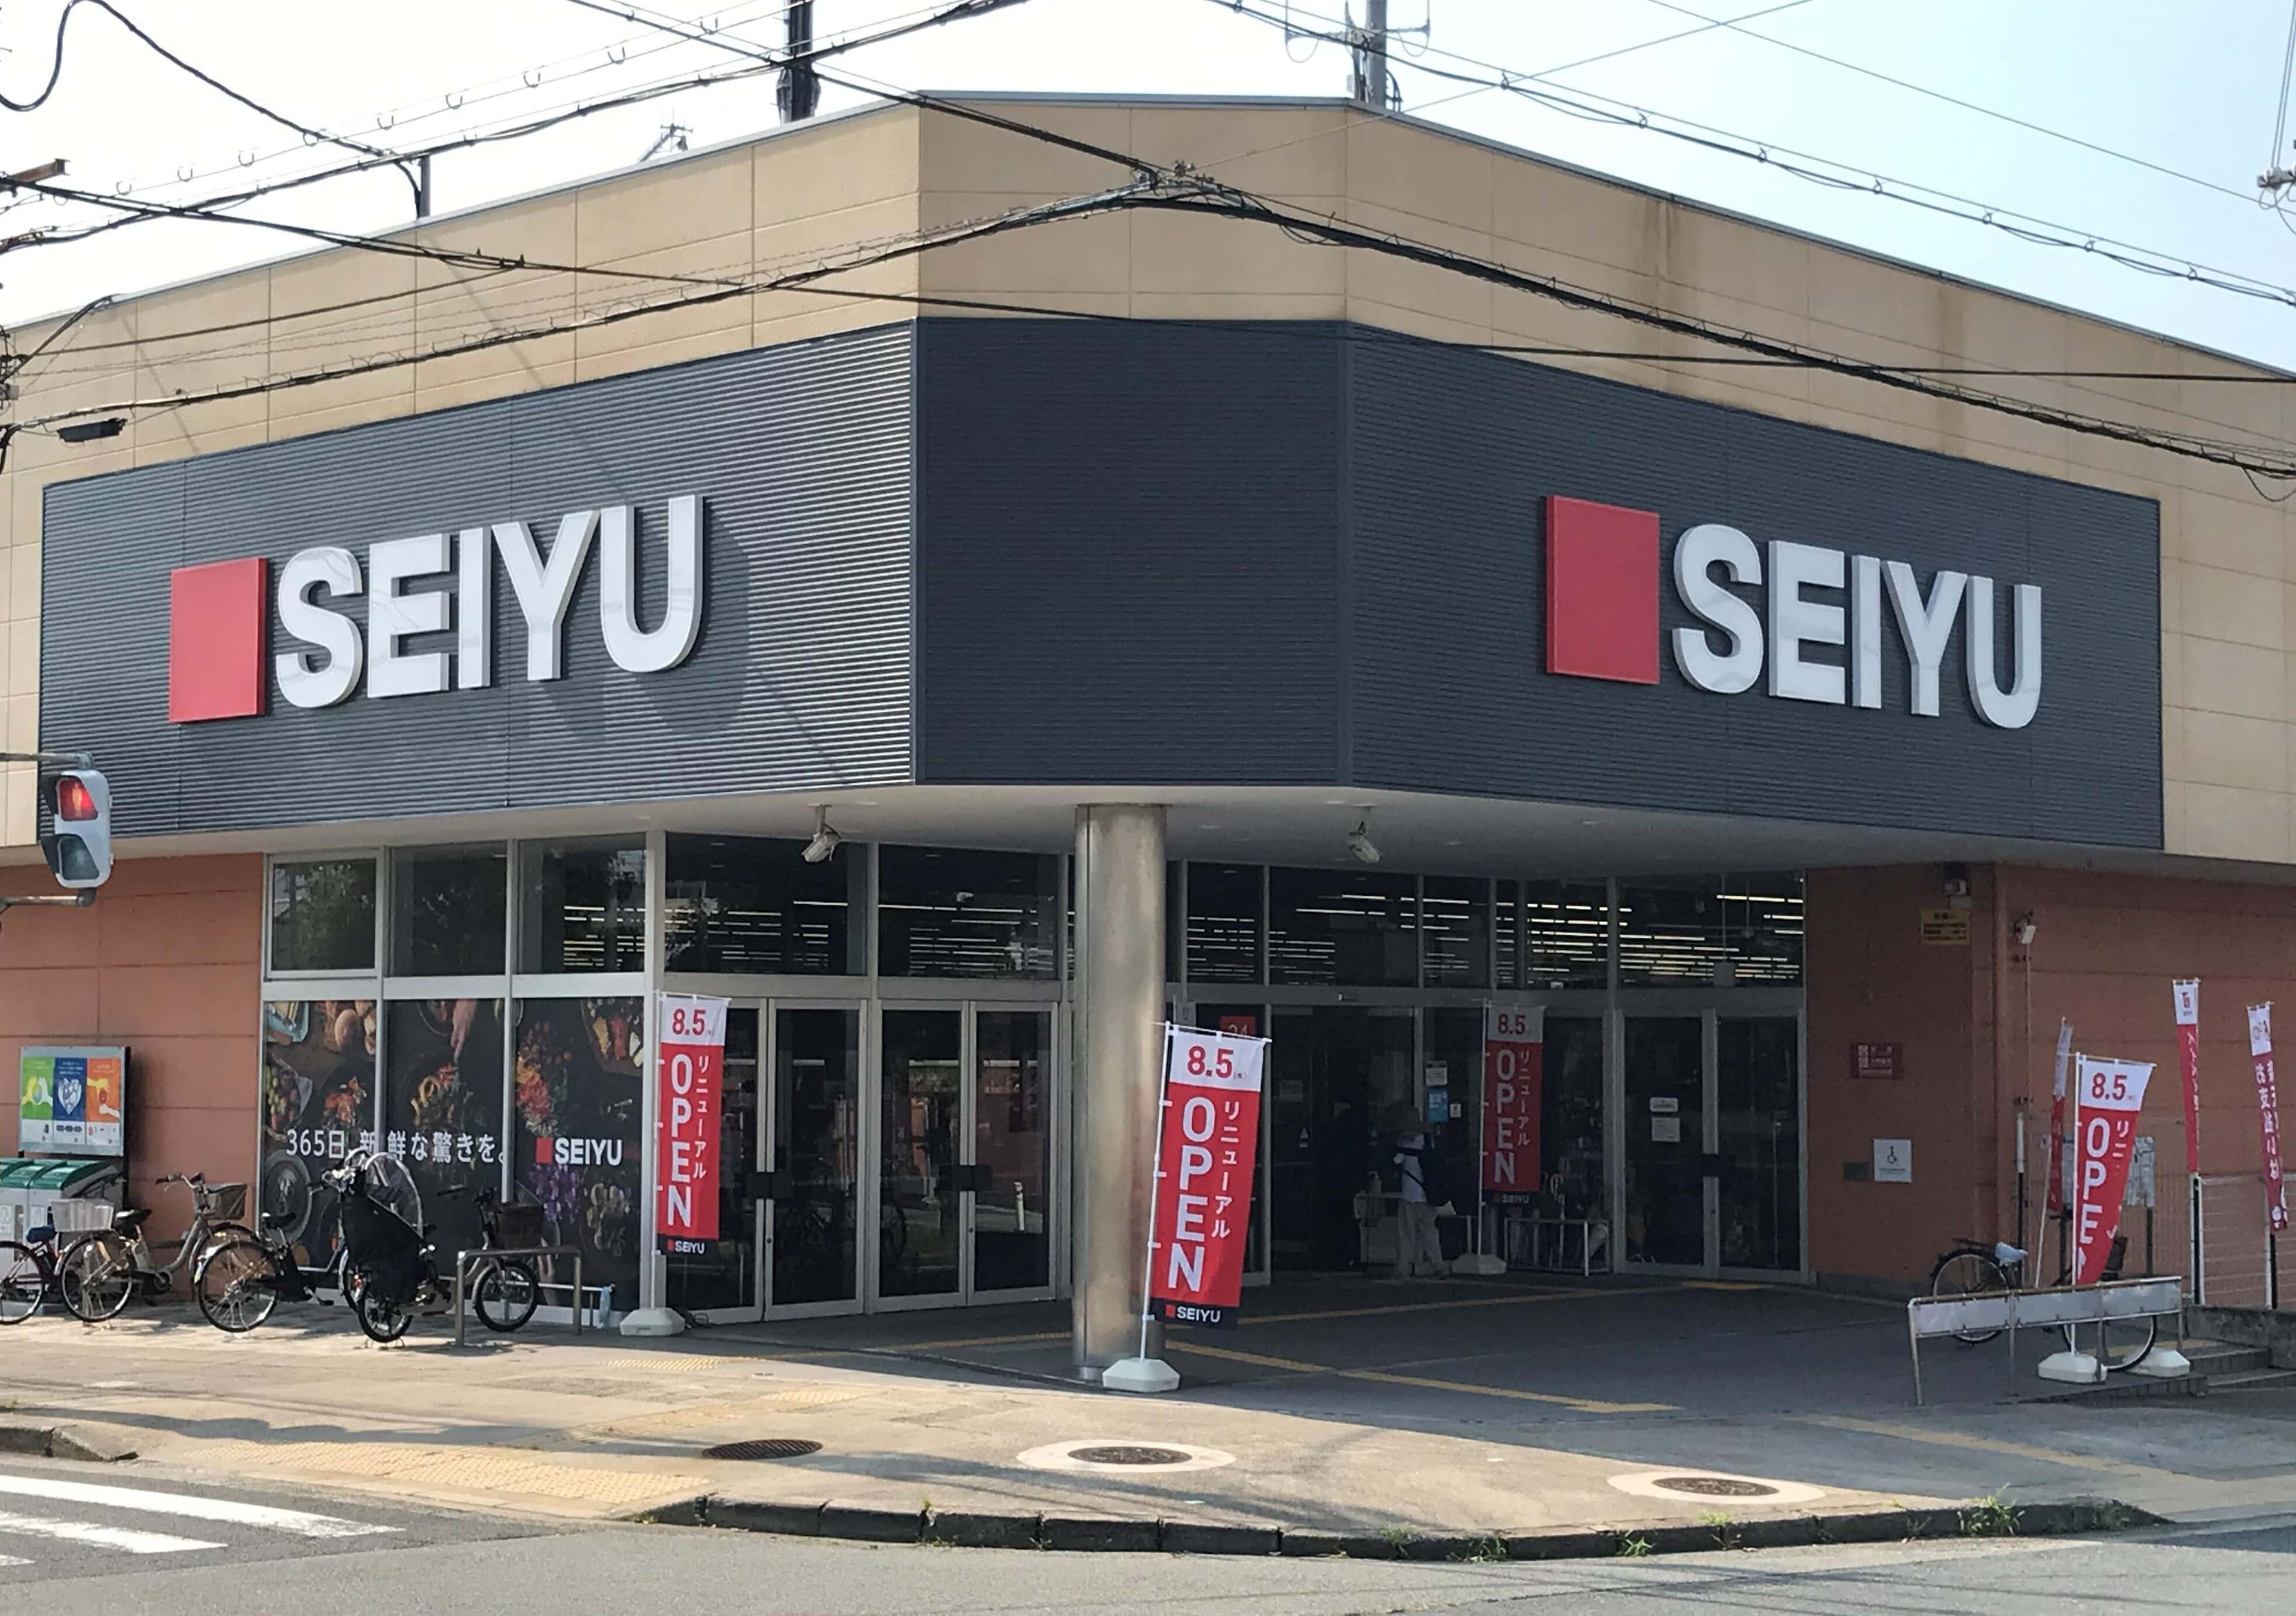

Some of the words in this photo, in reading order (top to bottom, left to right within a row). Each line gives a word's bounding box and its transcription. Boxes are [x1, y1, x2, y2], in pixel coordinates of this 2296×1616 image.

[276, 495, 704, 709] SEIYU
[1672, 523, 2042, 729] SEIYU
[672, 1008, 706, 1035] 8.5
[1187, 1045, 1234, 1078] 8.5
[1497, 1013, 1526, 1035] 8.5
[692, 1055, 710, 1179] リニューアル
[1494, 1049, 1516, 1184] OPEN
[1517, 1050, 1531, 1147] リニューアル
[2092, 1072, 2128, 1101] 8.5
[555, 1137, 622, 1166] SEIYU
[667, 1054, 693, 1228] OPEN
[1211, 1101, 1240, 1239] リニューアル
[1168, 1096, 1216, 1292] OPEN
[674, 1240, 705, 1255] SEIYU
[1177, 1306, 1220, 1323] SEIYU
